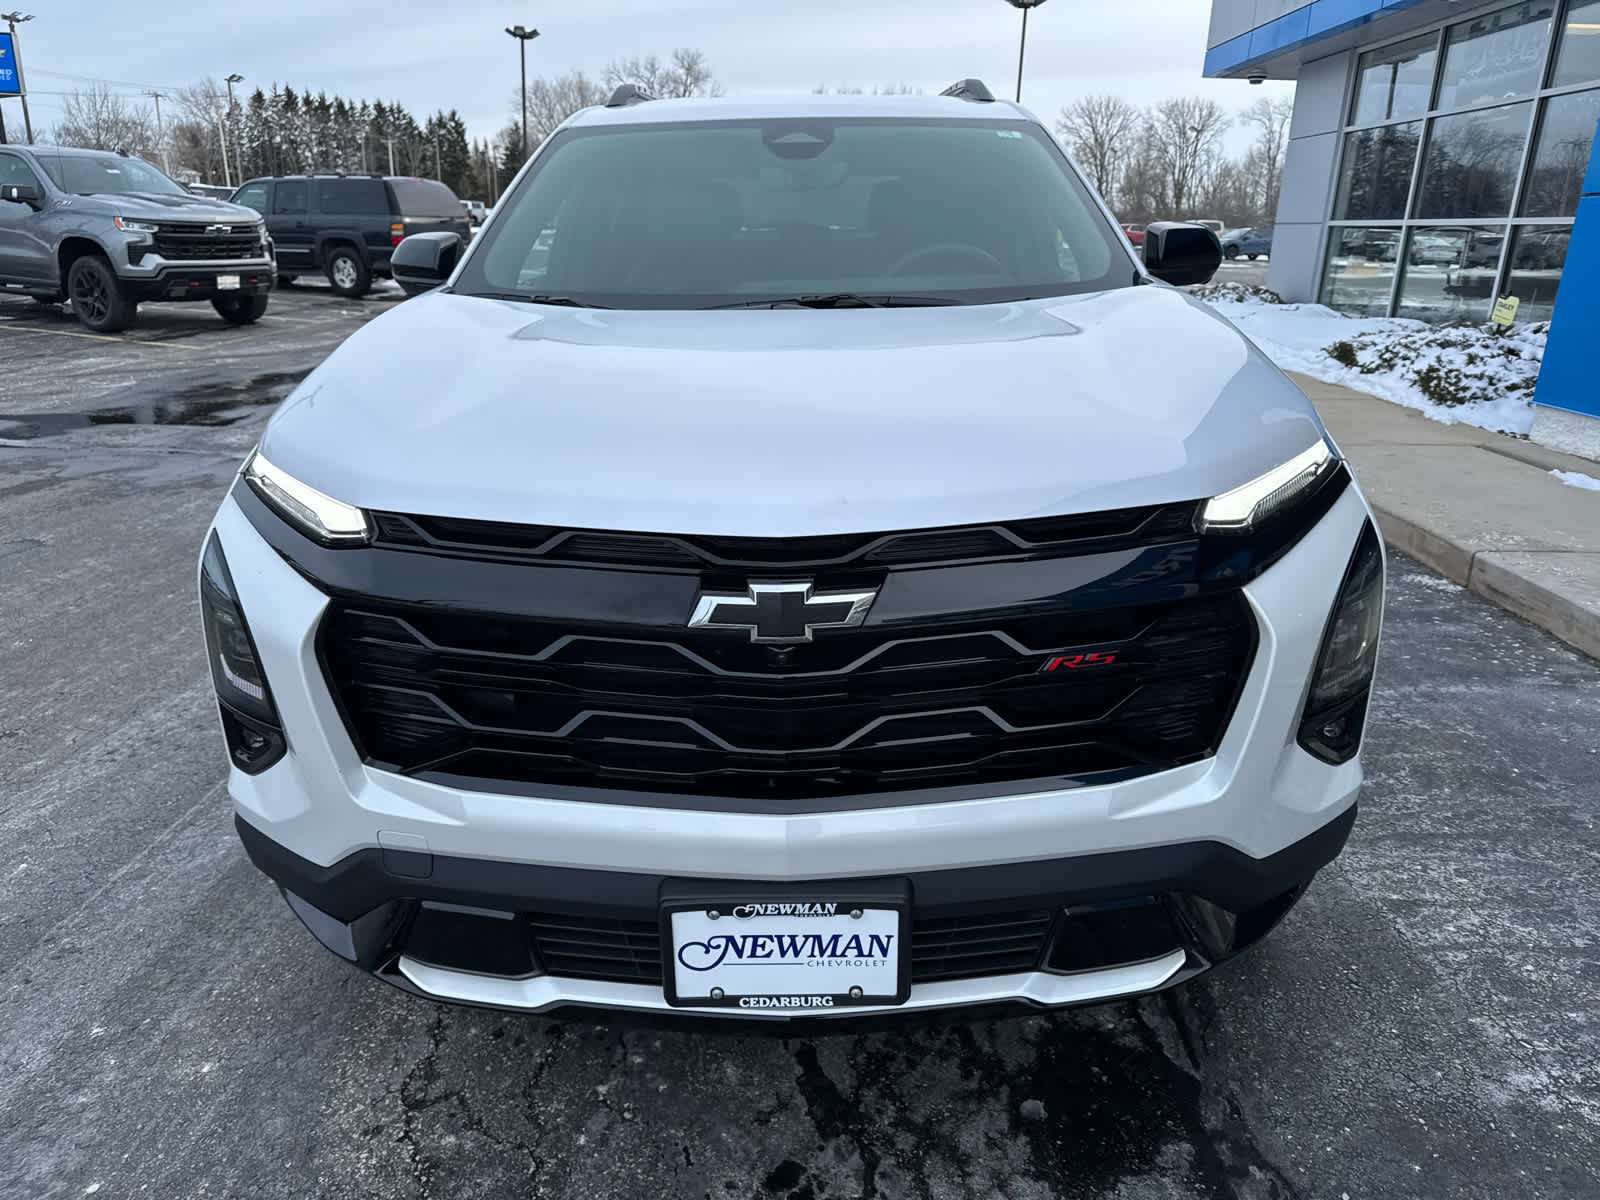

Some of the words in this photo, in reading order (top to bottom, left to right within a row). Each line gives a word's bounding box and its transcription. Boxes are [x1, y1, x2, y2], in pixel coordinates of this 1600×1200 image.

[1045, 650, 1118, 671] RS
[733, 903, 837, 920] NEWMAN
[678, 934, 894, 971] NEWMAN
[807, 959, 887, 968] CHEVROLET
[739, 996, 834, 1007] CEDARBURG
